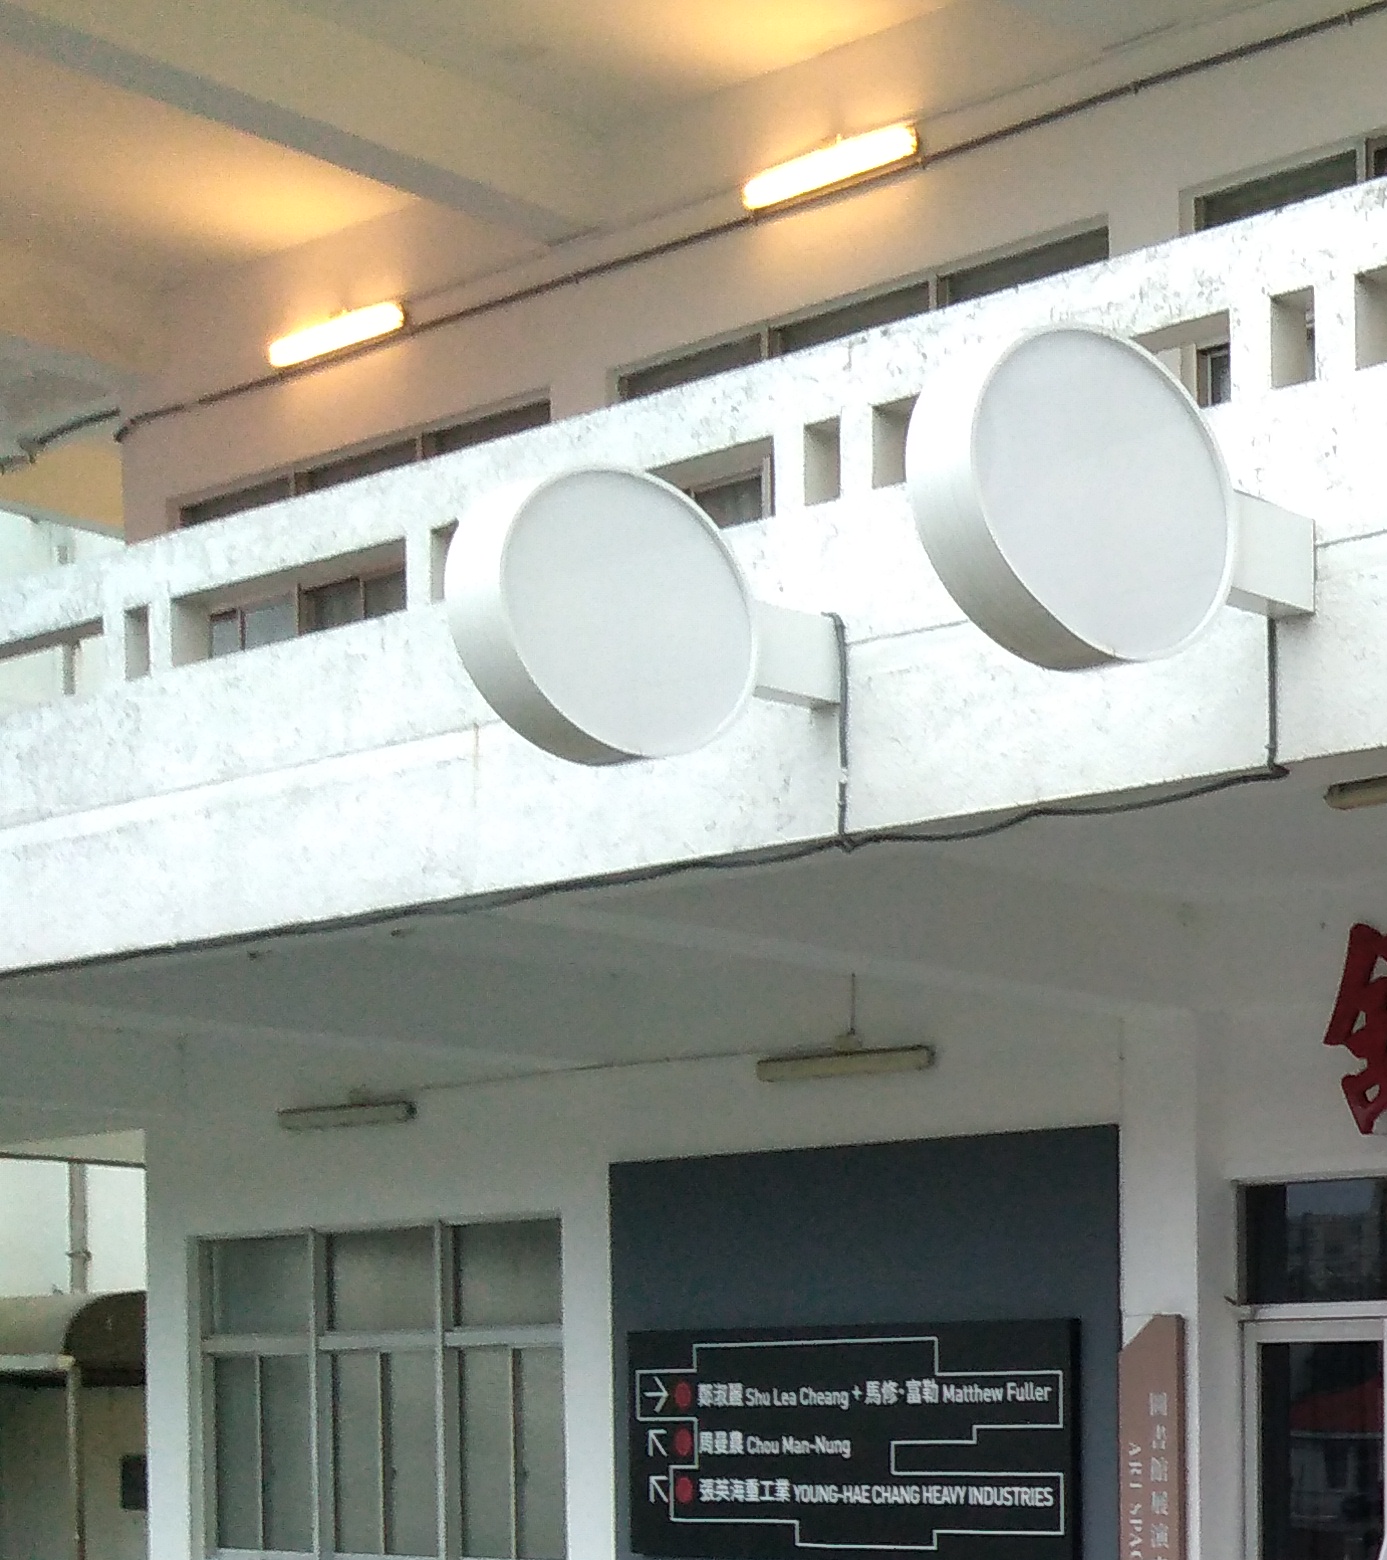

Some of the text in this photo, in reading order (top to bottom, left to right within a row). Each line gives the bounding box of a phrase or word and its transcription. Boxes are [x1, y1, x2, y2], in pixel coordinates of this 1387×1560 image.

[745, 1388, 771, 1406] Shu
[773, 1389, 797, 1406] Lea
[800, 1387, 849, 1410] Cheang
[942, 1384, 1003, 1403] Matthew
[1007, 1381, 1052, 1401] Fuller
[747, 1436, 779, 1454] Chou
[782, 1436, 851, 1459] Man-Nung
[793, 1484, 870, 1504] YOUNG-HAE
[872, 1485, 920, 1504] CHANG
[922, 1485, 966, 1504] HEAVY
[968, 1486, 1053, 1506] INDUSTRIES
